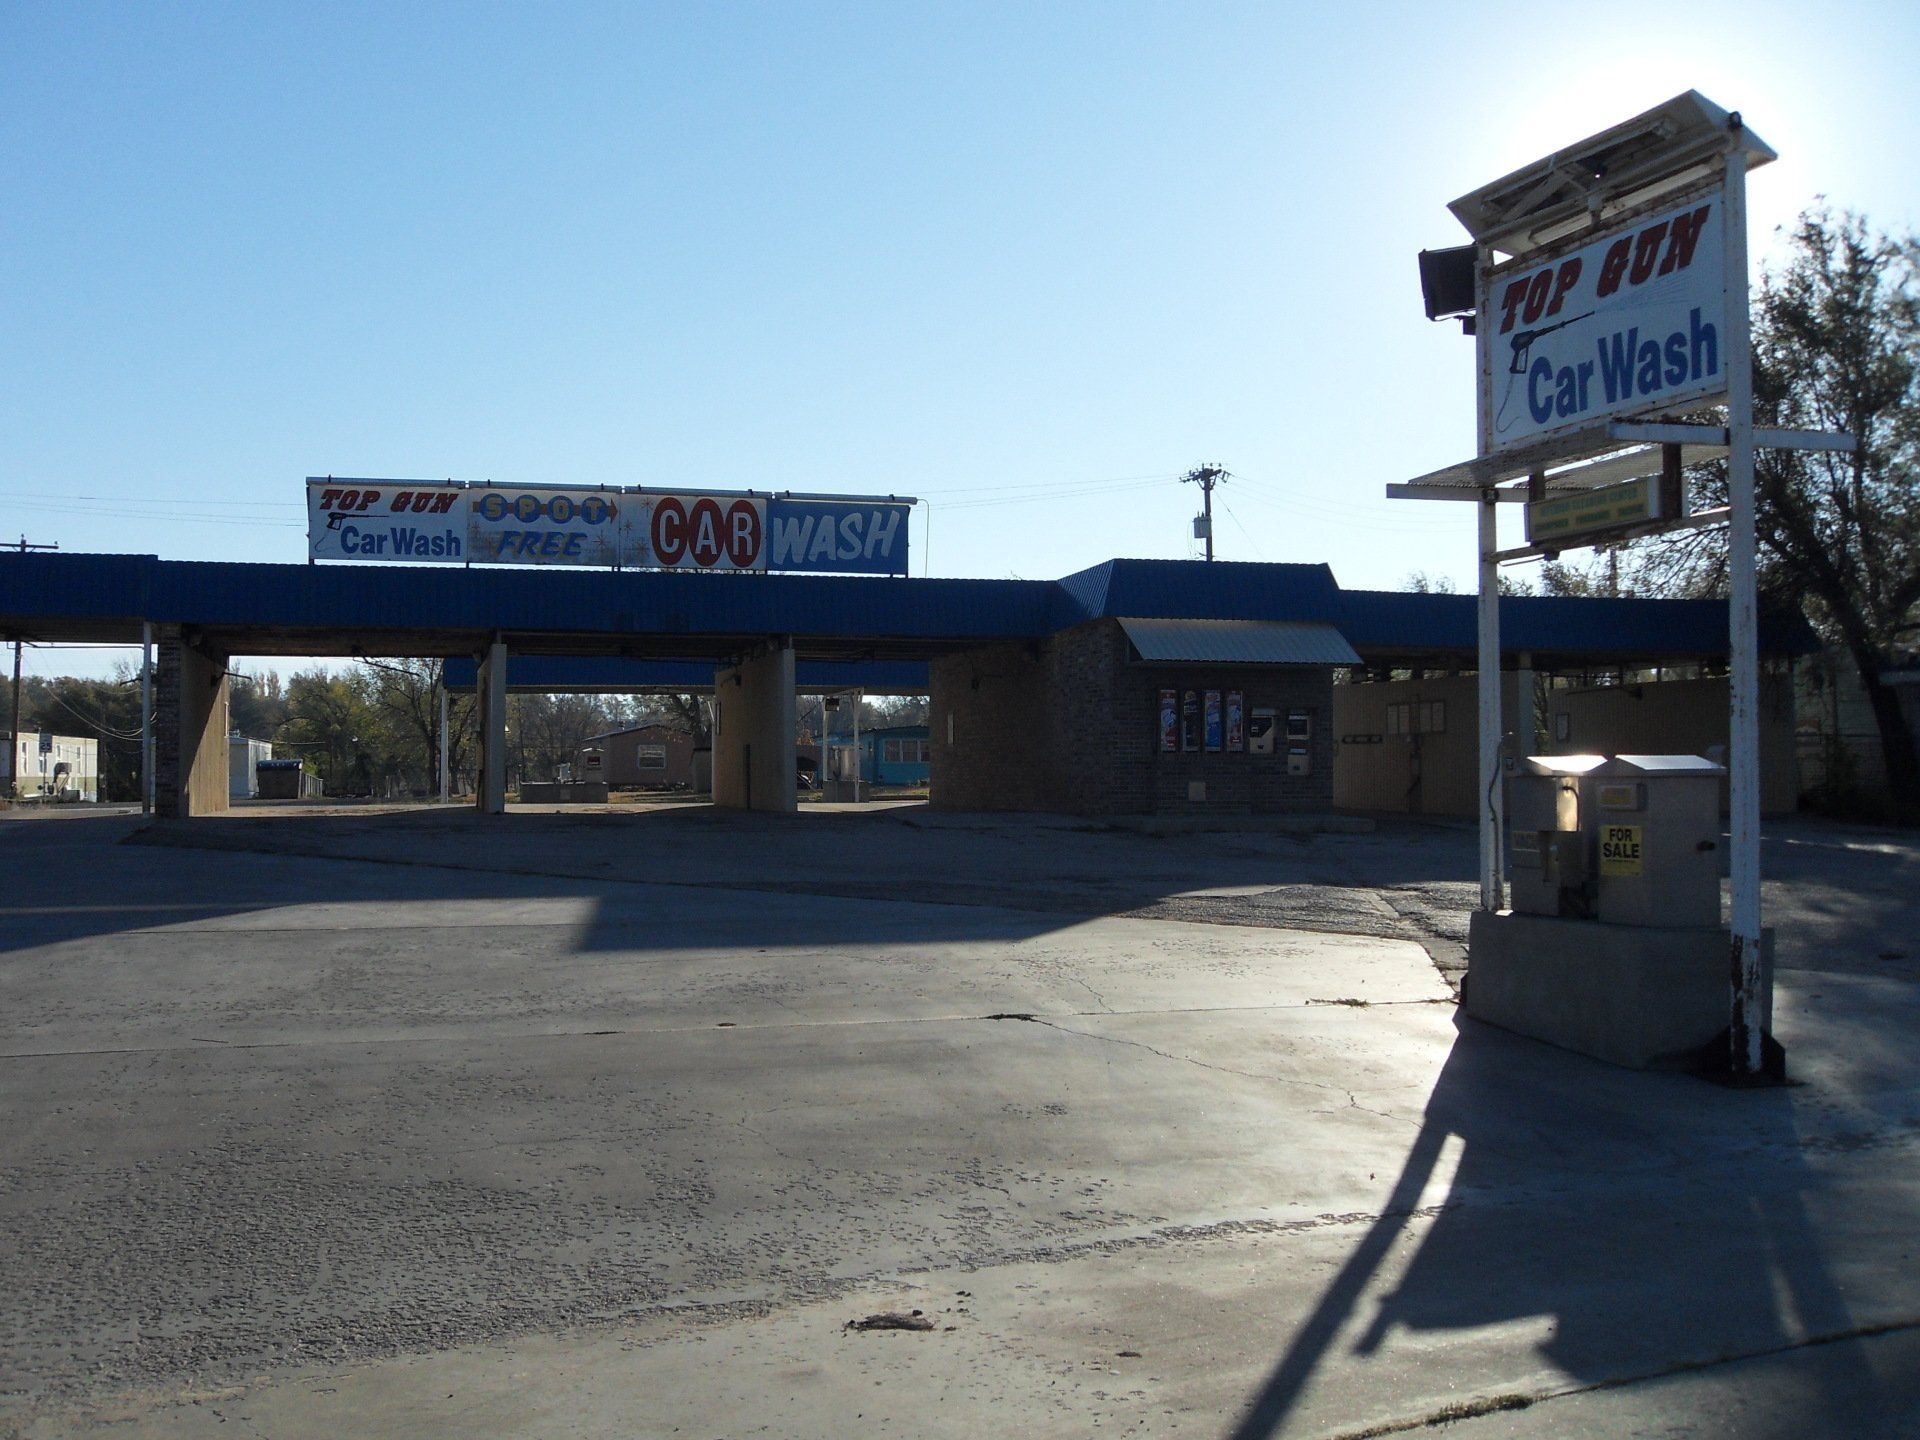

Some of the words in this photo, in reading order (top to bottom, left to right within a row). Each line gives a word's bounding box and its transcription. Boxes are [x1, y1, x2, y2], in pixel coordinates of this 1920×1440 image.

[1499, 257, 1583, 335] TOP
[1596, 204, 1711, 298] GUN
[1528, 356, 1594, 425] Car
[1597, 307, 1718, 404] Wash
[319, 489, 381, 511] TOP
[390, 491, 459, 513] GUN
[485, 497, 603, 521] SPOT
[340, 525, 389, 555] Car
[390, 527, 461, 556] Wash
[496, 530, 588, 556] FREE
[659, 510, 753, 556] CAR
[773, 510, 900, 565] WASH
[1609, 828, 1633, 842] FOR
[1602, 842, 1640, 859] SALE
